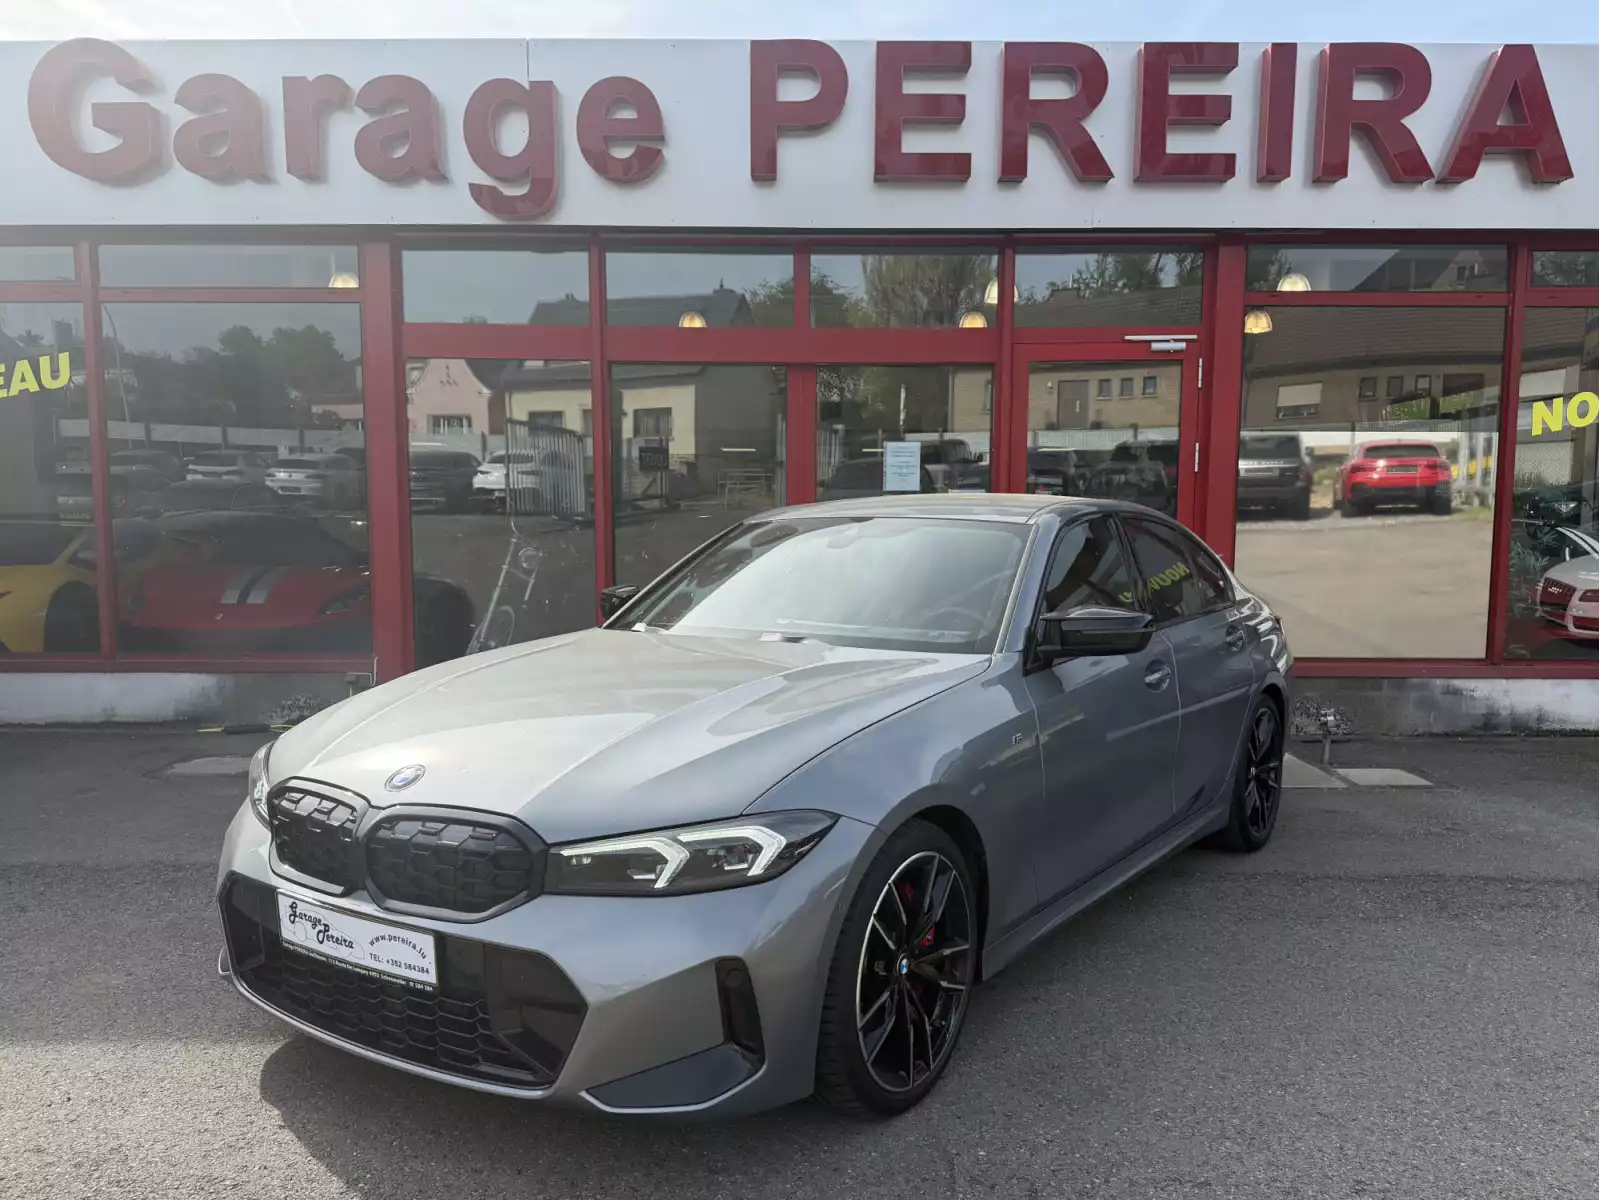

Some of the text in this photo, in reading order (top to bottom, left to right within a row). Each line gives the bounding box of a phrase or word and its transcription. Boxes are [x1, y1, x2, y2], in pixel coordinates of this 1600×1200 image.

[27, 37, 1575, 221] Garage PEREIRA
[1532, 391, 1599, 436] NO
[289, 901, 322, 929] Garage
[317, 923, 354, 949] Pereira
[369, 934, 427, 960] www.pereira.lu
